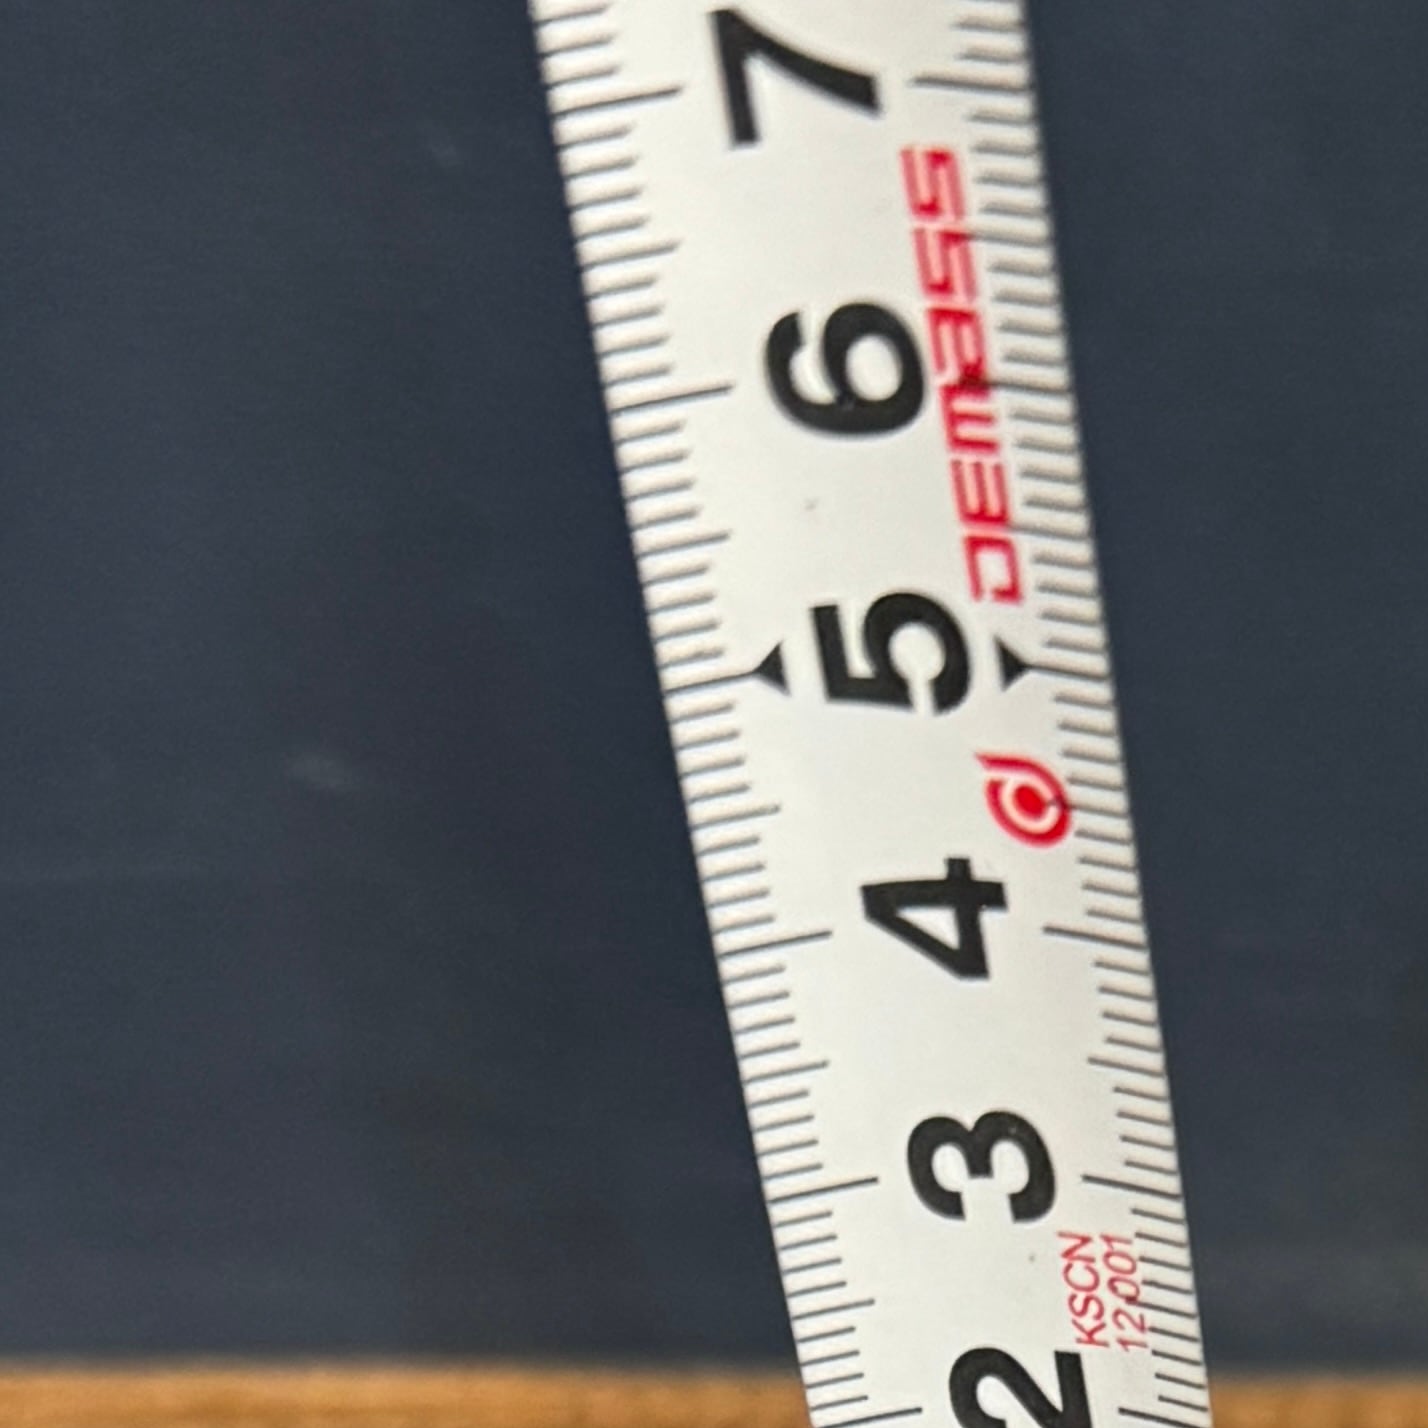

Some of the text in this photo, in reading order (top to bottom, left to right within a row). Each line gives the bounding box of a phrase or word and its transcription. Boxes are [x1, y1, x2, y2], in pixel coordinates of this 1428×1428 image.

[713, 9, 880, 145] 7
[766, 302, 925, 437] 6
[813, 592, 971, 714] 5
[862, 857, 1007, 980] 4
[908, 1111, 1055, 1222] 3
[1057, 1231, 1110, 1348] KSCN
